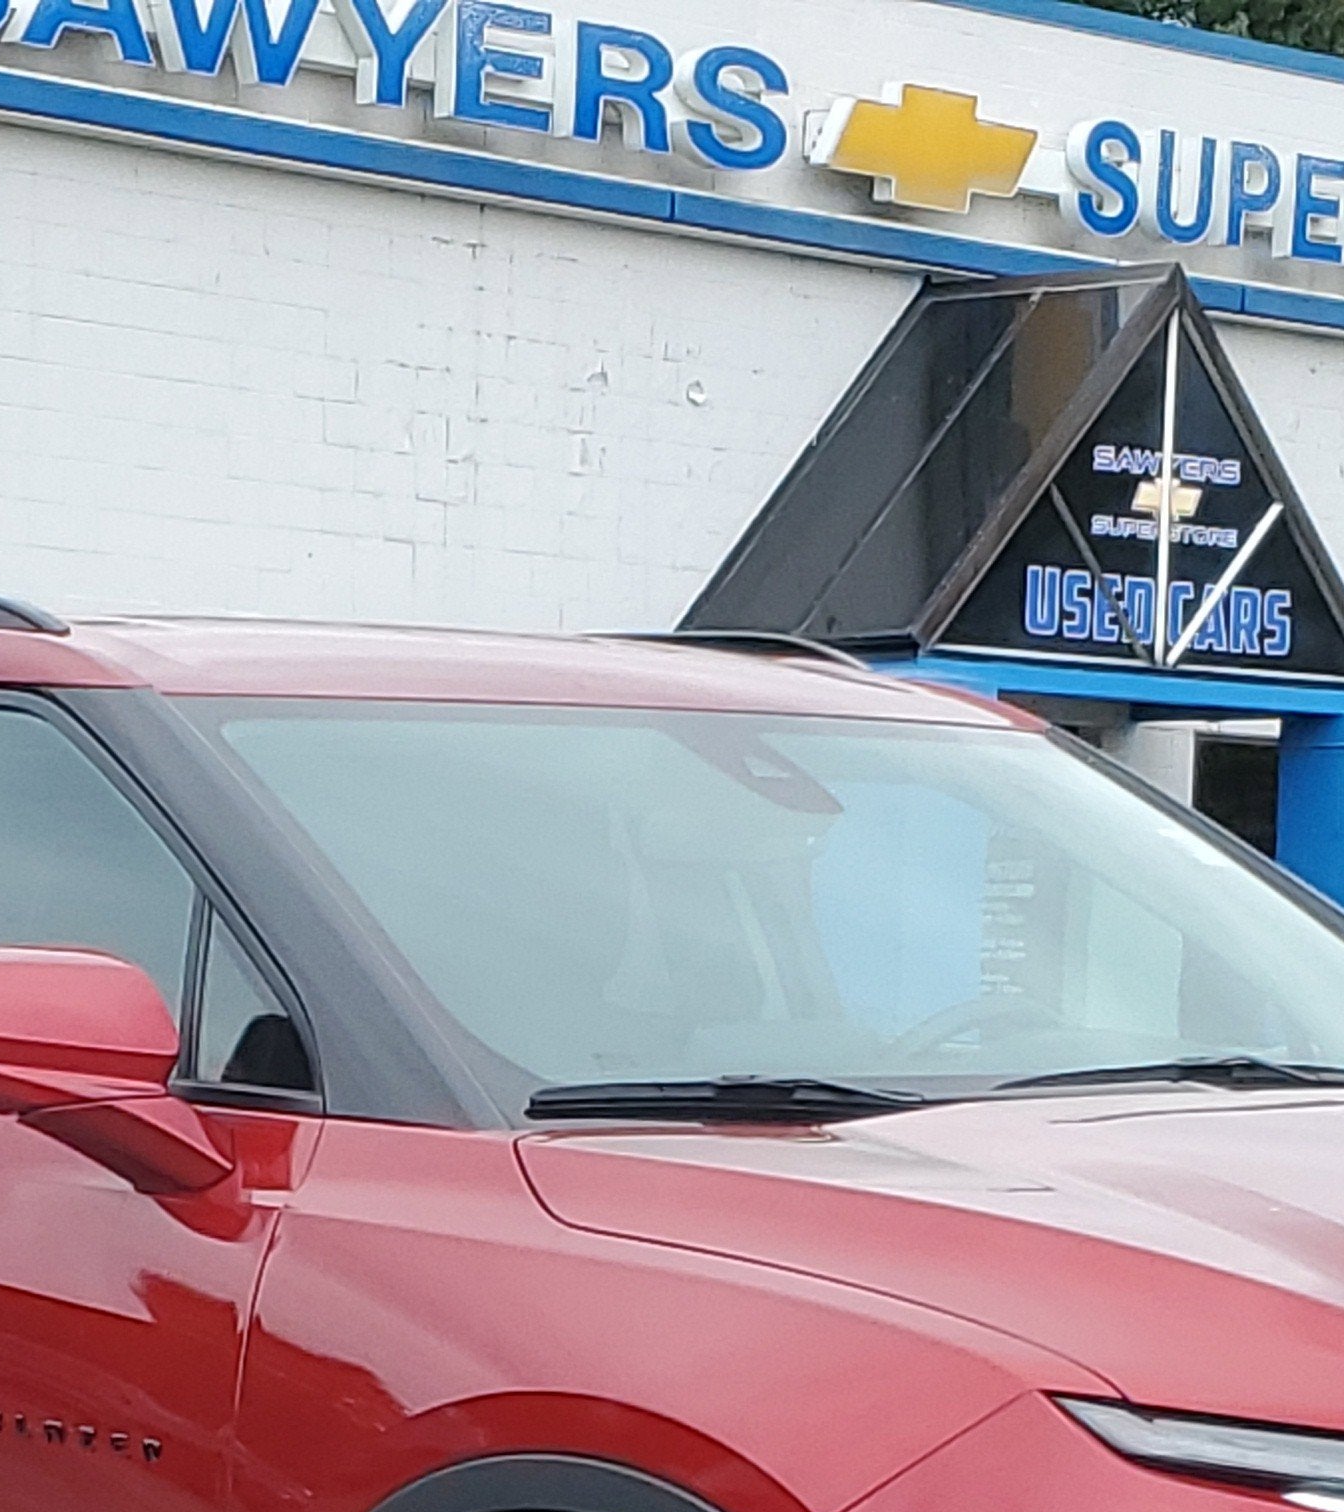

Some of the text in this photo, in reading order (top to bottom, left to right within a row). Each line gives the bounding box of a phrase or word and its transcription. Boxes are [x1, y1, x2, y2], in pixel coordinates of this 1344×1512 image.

[1091, 515, 1238, 548] SUPESTORE
[1025, 566, 1292, 656] USED CARS
